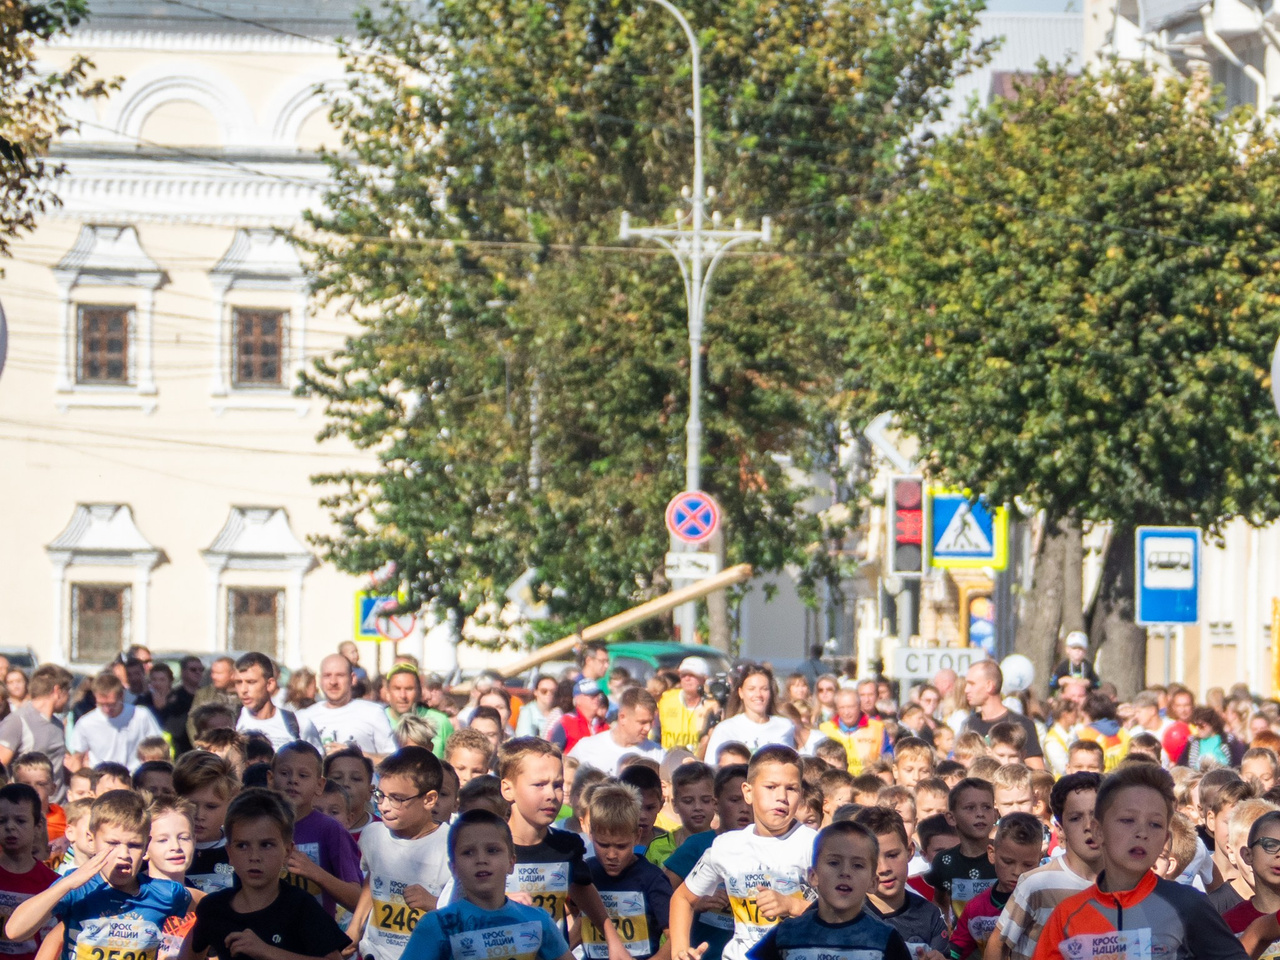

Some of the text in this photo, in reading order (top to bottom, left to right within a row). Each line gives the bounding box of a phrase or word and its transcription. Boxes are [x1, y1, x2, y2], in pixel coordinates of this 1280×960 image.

[906, 653, 971, 673] СТОП
[518, 867, 540, 875] КРОСС
[518, 875, 545, 883] НАЦИИ
[108, 931, 139, 939] НАЦИИ
[482, 930, 505, 940] КРОСС
[484, 937, 515, 948] НАЦИИ
[1093, 936, 1118, 947] КРОСС
[1092, 944, 1127, 956] НАЦИИ
